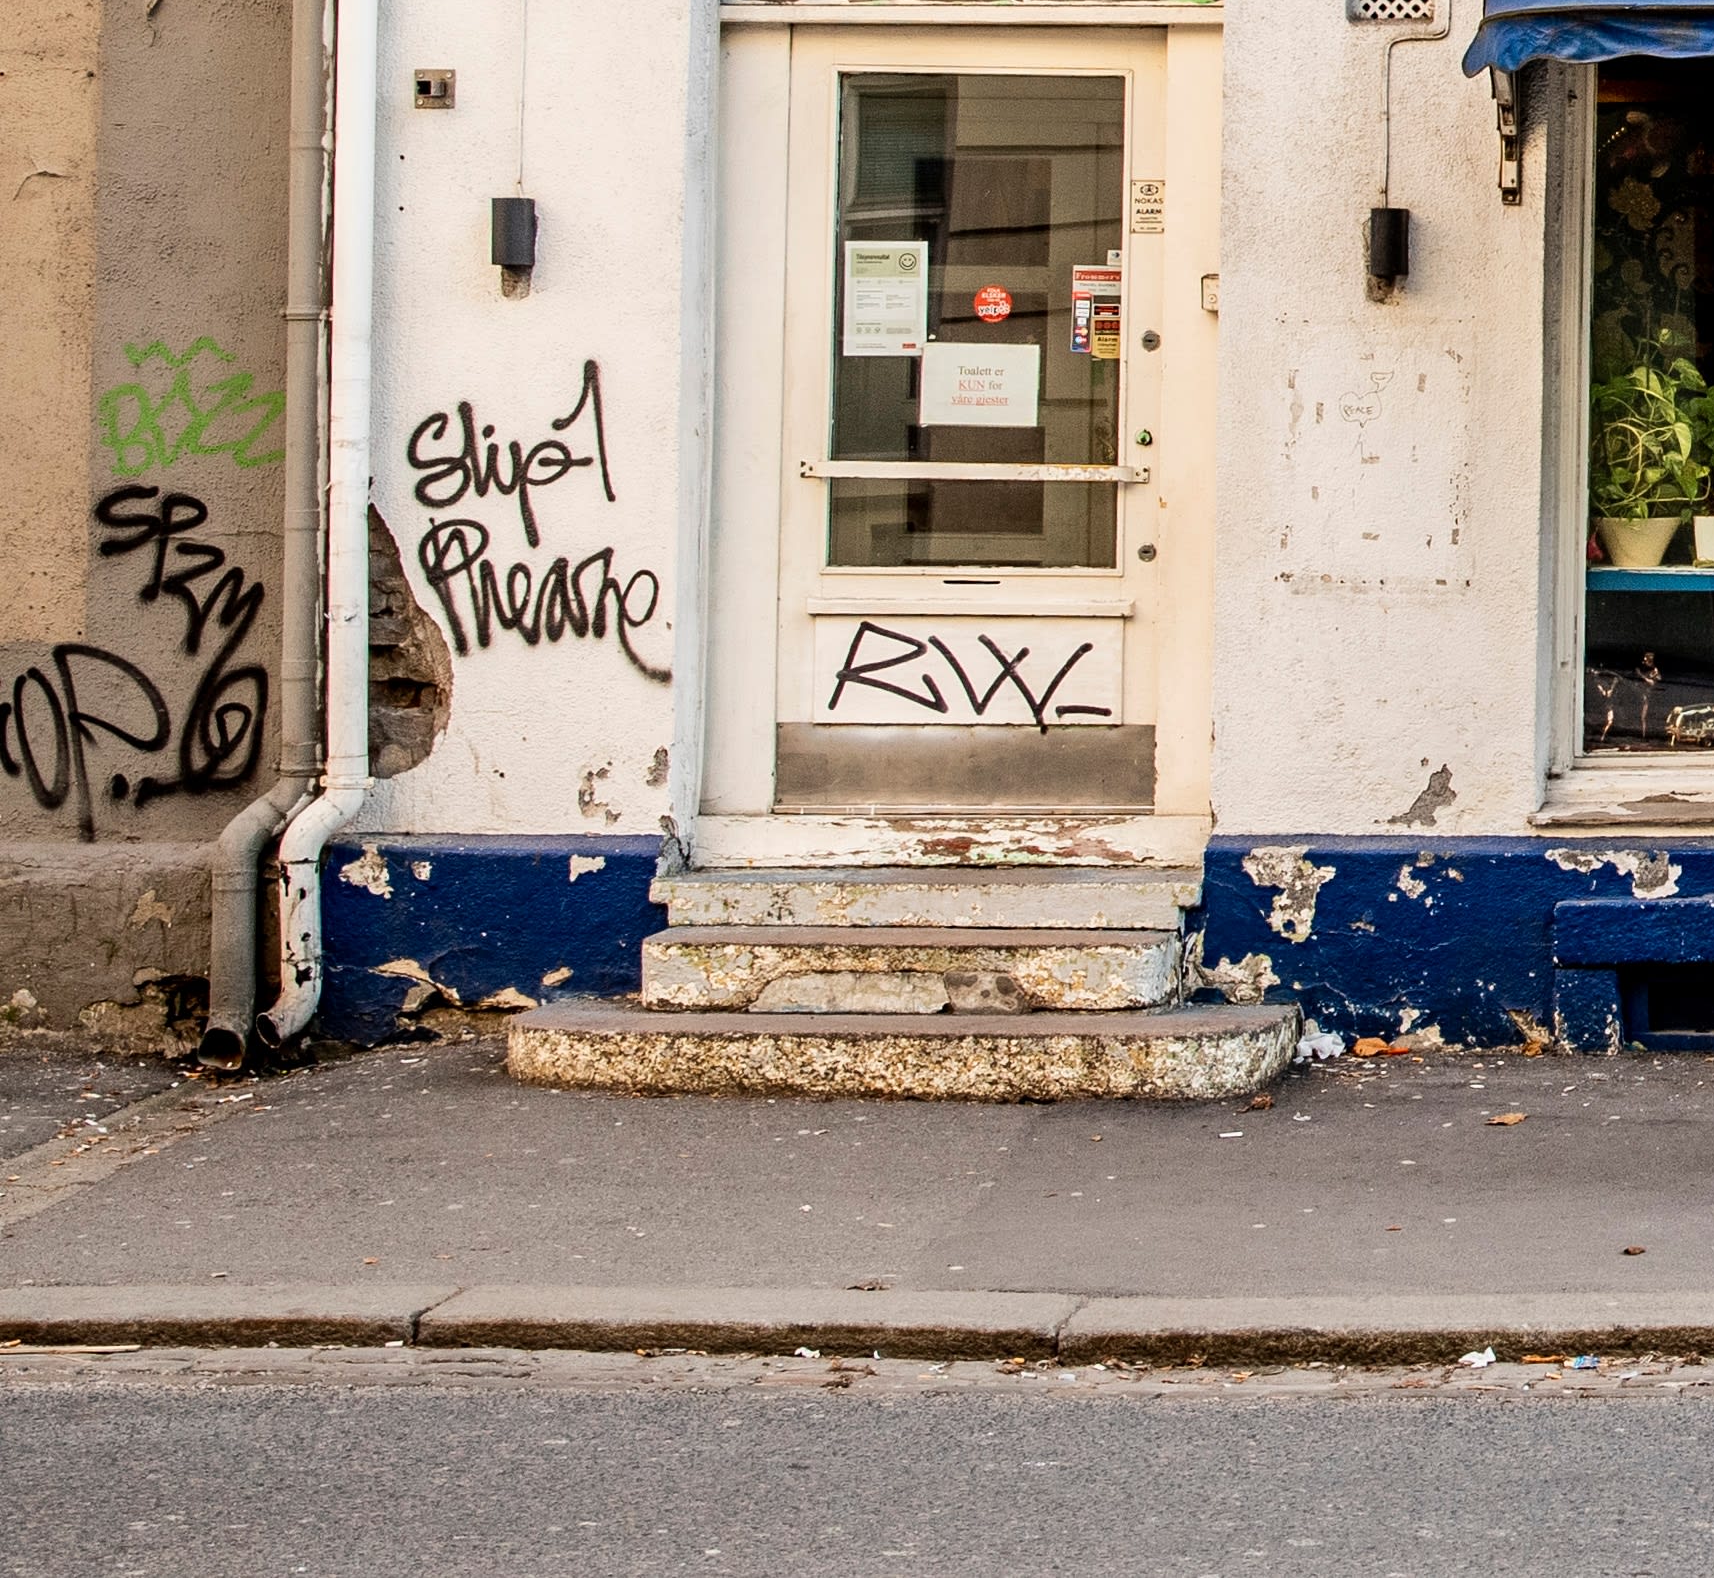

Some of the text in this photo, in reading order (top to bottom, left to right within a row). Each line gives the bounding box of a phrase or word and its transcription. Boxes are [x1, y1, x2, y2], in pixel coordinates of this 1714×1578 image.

[1134, 197, 1164, 205] NOKAS
[957, 365, 1005, 377] Toalett er
[958, 379, 1003, 392] KUN for
